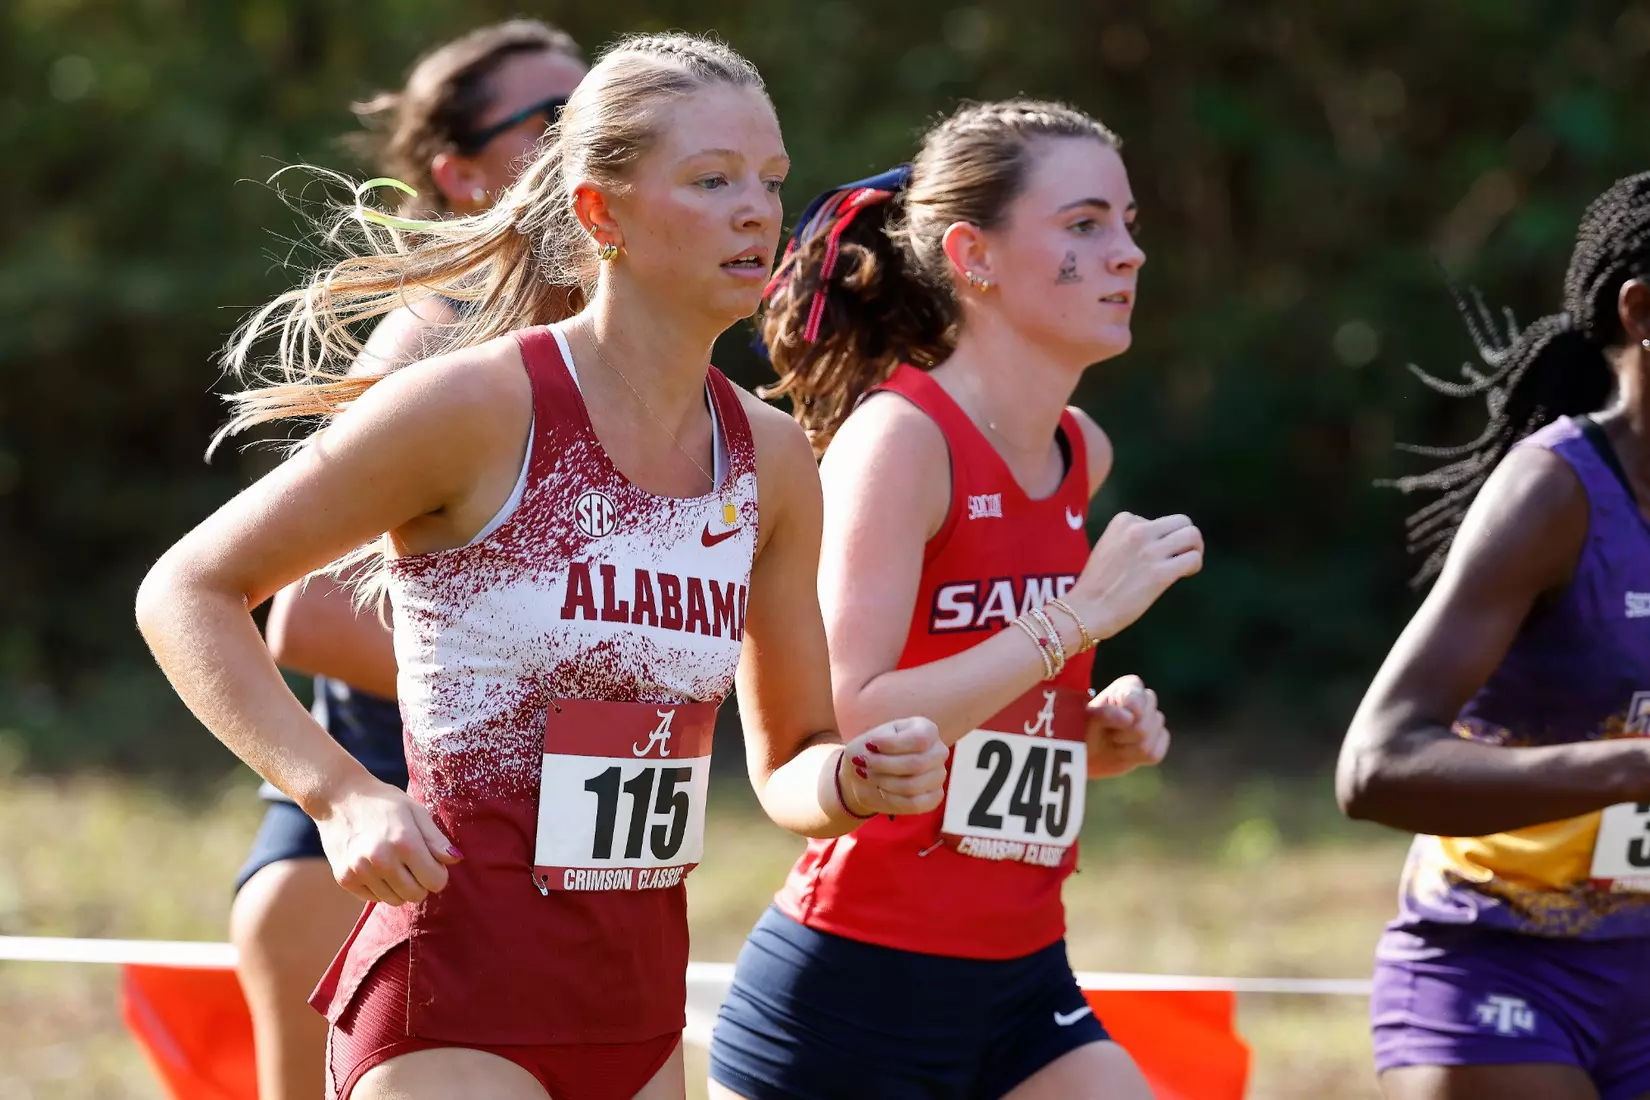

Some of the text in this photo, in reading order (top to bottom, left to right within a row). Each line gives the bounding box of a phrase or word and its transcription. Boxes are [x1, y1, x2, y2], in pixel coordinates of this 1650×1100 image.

[576, 493, 615, 537] SEC
[632, 708, 676, 757] A
[1023, 690, 1057, 737] A
[967, 739, 1073, 838] 245
[584, 766, 693, 860] 115
[956, 835, 1026, 861] CRIMSON
[563, 866, 685, 891] CRIMSON CLASSIC
